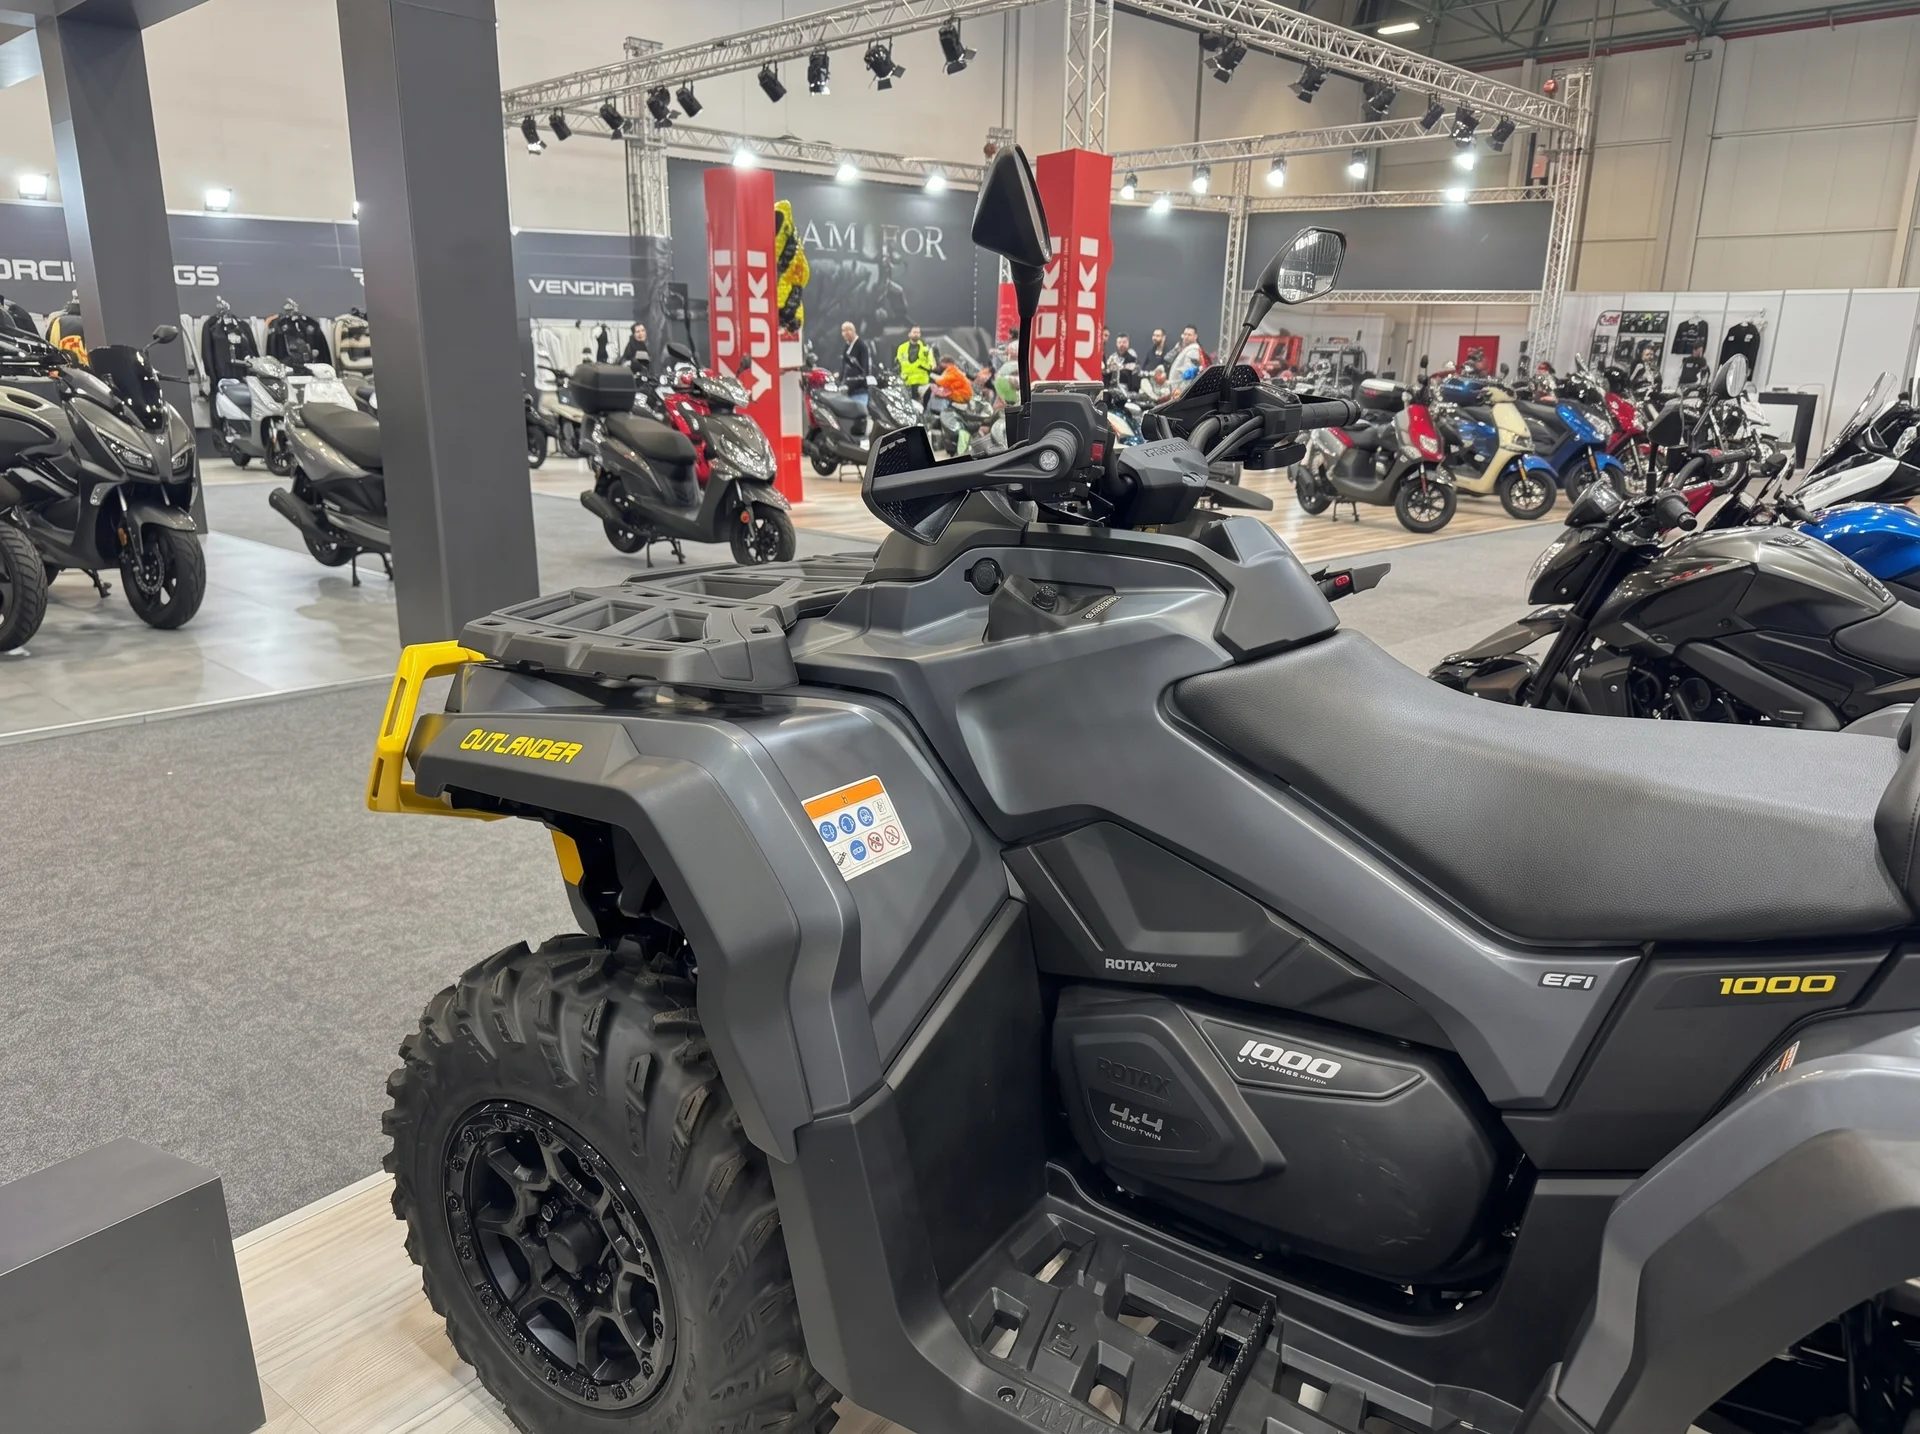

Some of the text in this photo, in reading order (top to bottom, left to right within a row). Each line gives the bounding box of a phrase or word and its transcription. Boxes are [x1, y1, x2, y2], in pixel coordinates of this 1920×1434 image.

[881, 224, 947, 261] FOR
[747, 250, 772, 402] YUKI
[460, 728, 583, 763] OUTLANDER
[1105, 958, 1155, 973] ROTAX
[1542, 973, 1594, 989] EFI
[1720, 975, 1836, 995] 1000
[1239, 1040, 1342, 1079] 1000
[1098, 1056, 1171, 1096] ROTAX
[1109, 1103, 1163, 1133] 4x4
[1138, 1128, 1162, 1141] TWIN
